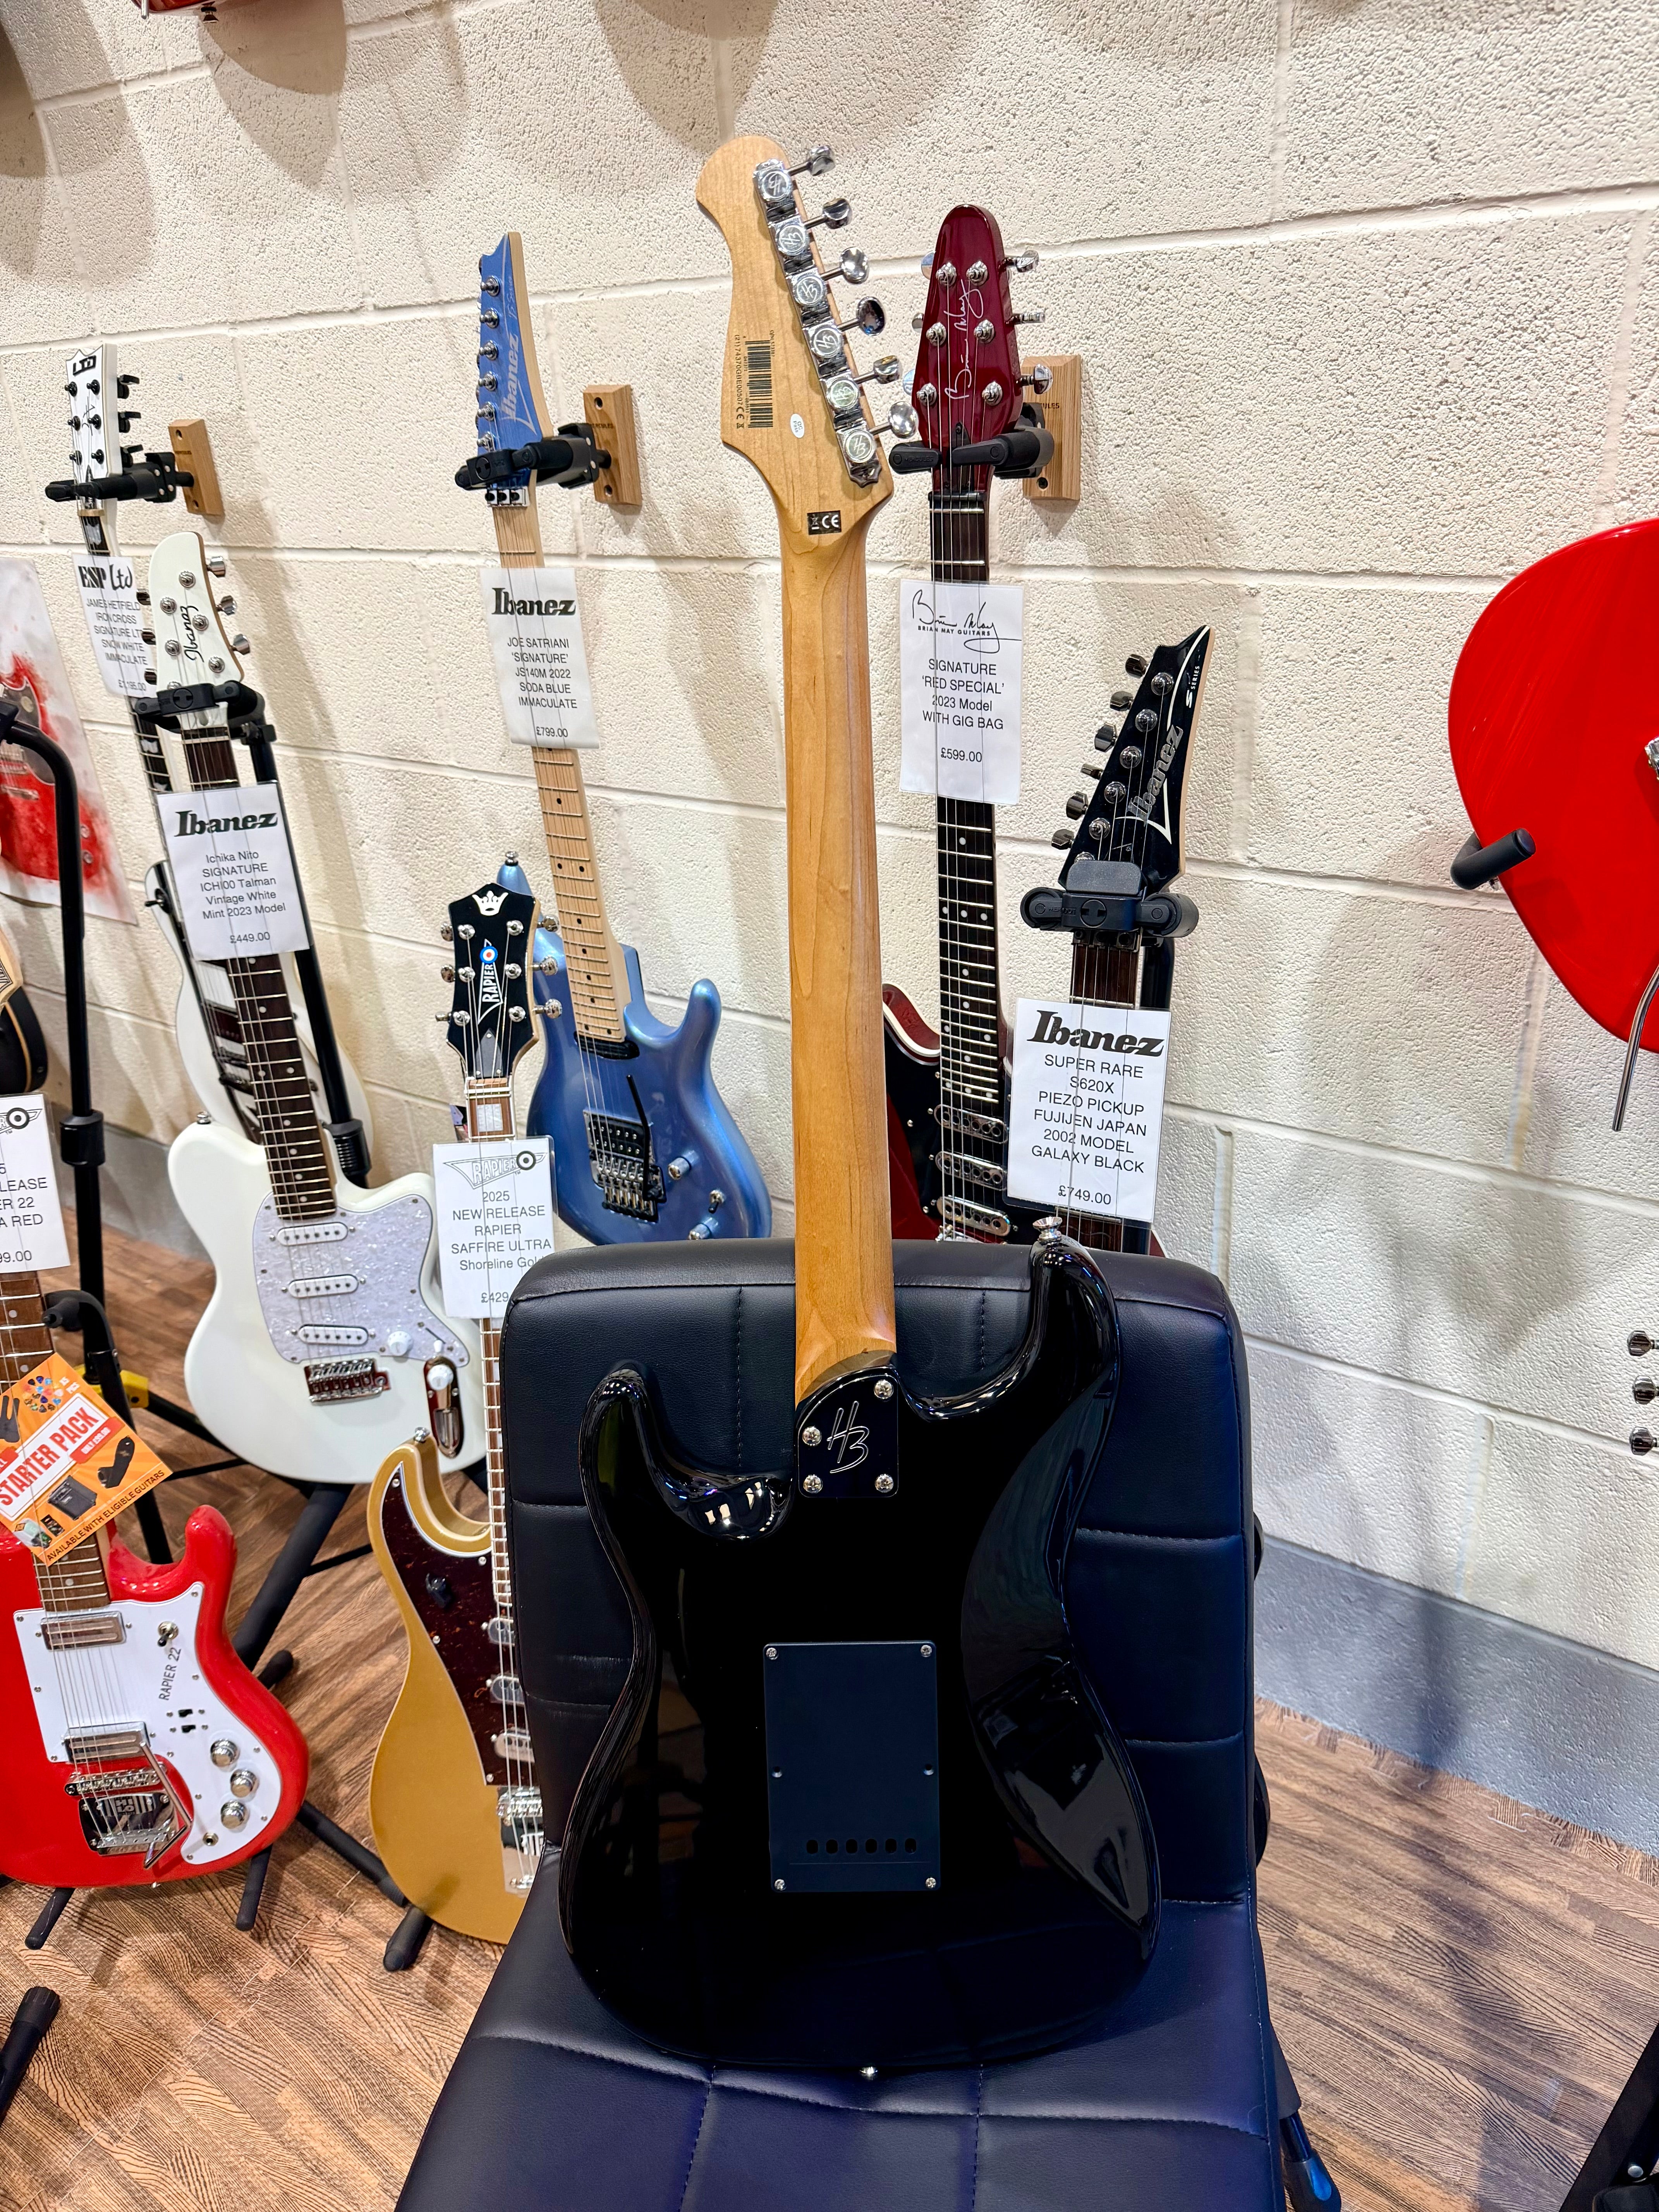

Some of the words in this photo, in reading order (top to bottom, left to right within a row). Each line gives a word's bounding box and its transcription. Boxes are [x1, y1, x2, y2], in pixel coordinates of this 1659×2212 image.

[501, 332, 519, 422] Ibanez
[78, 565, 106, 589] ESP
[110, 564, 132, 591] Ltd
[87, 598, 108, 608] JAMES
[108, 601, 141, 611] HETFIELD
[492, 587, 576, 616] Ibanez
[96, 612, 112, 622] IRON
[112, 614, 137, 624] CROSS
[94, 625, 132, 637] SIGNATURE
[132, 629, 142, 638] LT
[180, 606, 204, 663] Ibanez
[101, 639, 121, 649] SNOW
[121, 641, 145, 652] WHITE
[507, 637, 525, 647] JOE
[527, 638, 569, 649] SATRIANI
[105, 653, 148, 665] IMMACULATE
[929, 659, 997, 675] SIGNATURE
[515, 667, 547, 678] JS140M
[549, 669, 571, 679] 2022
[520, 682, 544, 692] SODA
[546, 684, 571, 694] BLUE
[1186, 689, 1193, 708] S
[1190, 666, 1200, 690] SERIES
[519, 696, 577, 709] IMMACULATE
[932, 694, 956, 708] 2023
[959, 698, 993, 711] Model
[922, 710, 949, 725] WITH
[953, 714, 974, 727] GIG
[978, 717, 1003, 730] BAG
[536, 726, 568, 738] £799.00
[941, 747, 982, 763] £599.00
[1126, 724, 1184, 828] Ibanez
[174, 810, 278, 837] Ibanez
[206, 854, 235, 864] Ichika
[239, 851, 259, 860] Nito
[203, 863, 268, 878] SIGNATURE
[237, 878, 276, 888] Talman
[206, 895, 244, 905] Vintage
[246, 891, 276, 901] White
[203, 909, 225, 919] Mint
[227, 907, 252, 917] 2023
[255, 903, 286, 914] Model
[230, 931, 270, 944] £449.00
[482, 963, 500, 1003] RAPIER
[1027, 1010, 1165, 1057] Ibanez
[1044, 1054, 1096, 1072] SUPER
[1101, 1061, 1144, 1078] RARE
[1070, 1076, 1115, 1094] S620X
[1039, 1091, 1083, 1108] PIEZO
[1087, 1098, 1144, 1116] PICKUP
[1034, 1109, 1092, 1128] FUJIJEN
[1097, 1118, 1146, 1136] JAPAN
[1044, 1129, 1076, 1144] 2002
[1081, 1134, 1134, 1153] MODEL
[1032, 1145, 1090, 1164] GALAXY
[1095, 1155, 1144, 1173] BLACK
[472, 1156, 517, 1185] RAPIER
[17, 1197, 35, 1209] 22
[483, 1190, 510, 1202] 2025
[1058, 1185, 1111, 1205] £749.00
[12, 1214, 43, 1227] RED
[453, 1209, 483, 1221] NEW
[486, 1205, 545, 1219] RELEASE
[474, 1223, 521, 1236] RAPIER
[451, 1241, 504, 1254] SAFFIRE
[508, 1239, 551, 1251] ULTRA
[0, 1250, 32, 1263] 9.00
[460, 1259, 513, 1271] Shoreline
[517, 1256, 544, 1268] Gol
[1, 1444, 61, 1506] STARTER
[49, 1407, 99, 1451] PACK
[46, 1528, 85, 1562] AVAILABLE
[84, 1515, 104, 1532] WITH
[103, 1491, 138, 1518] ELIGIBLE
[134, 1470, 165, 1494] GUITARS
[158, 1664, 178, 1701] RAPIER
[168, 1646, 182, 1662] 22
